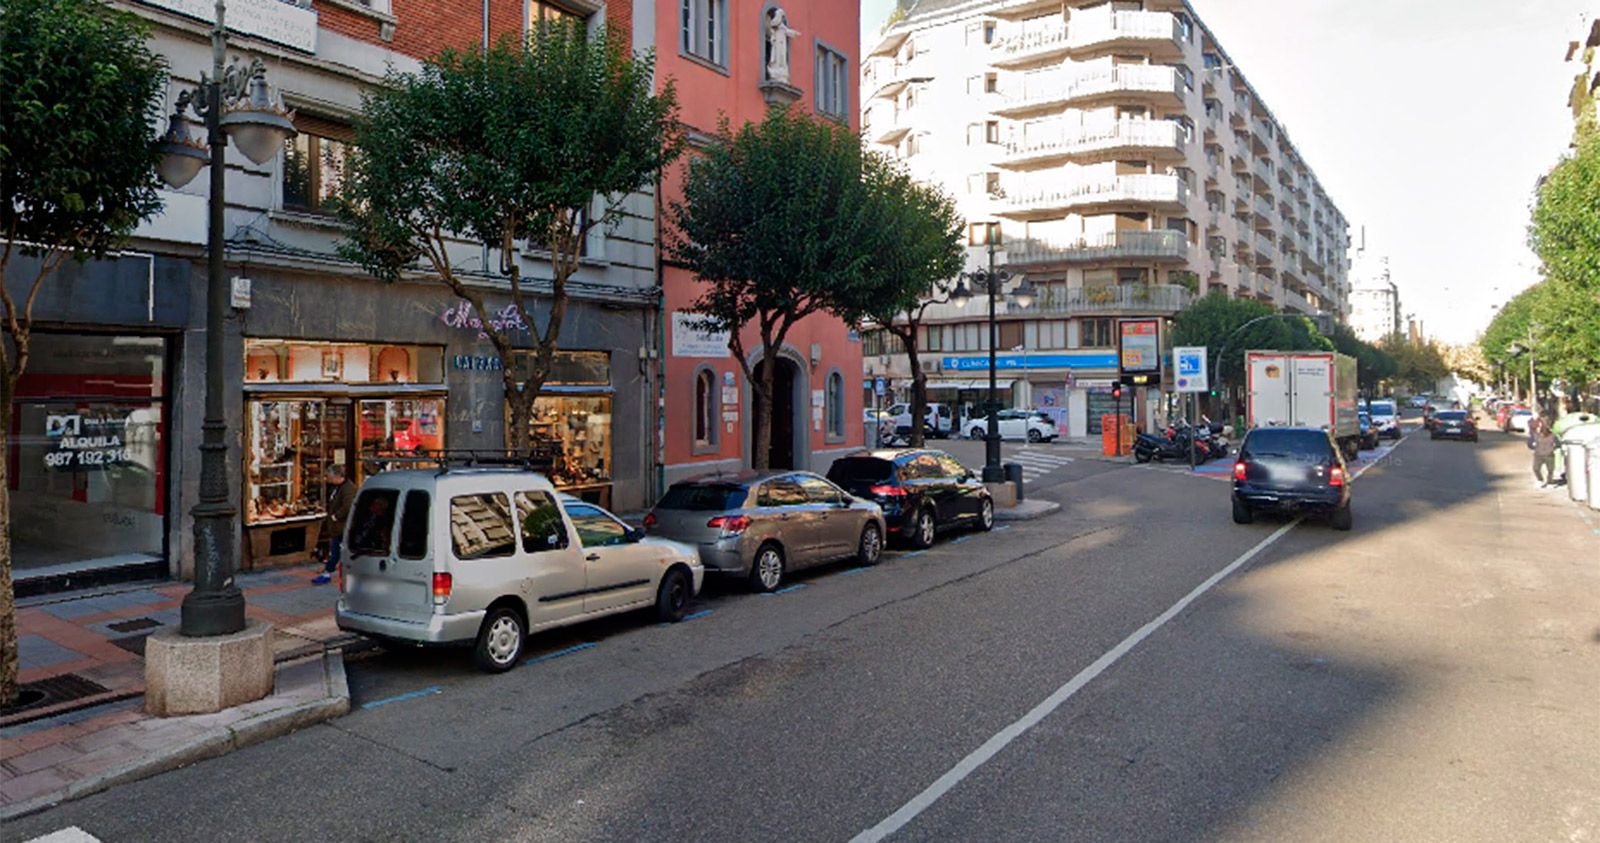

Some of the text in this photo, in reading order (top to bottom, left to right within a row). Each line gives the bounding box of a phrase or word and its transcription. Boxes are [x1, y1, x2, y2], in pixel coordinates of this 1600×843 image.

[59, 435, 121, 449] ALQUILA
[45, 451, 74, 466] 987
[77, 450, 104, 465] 192
